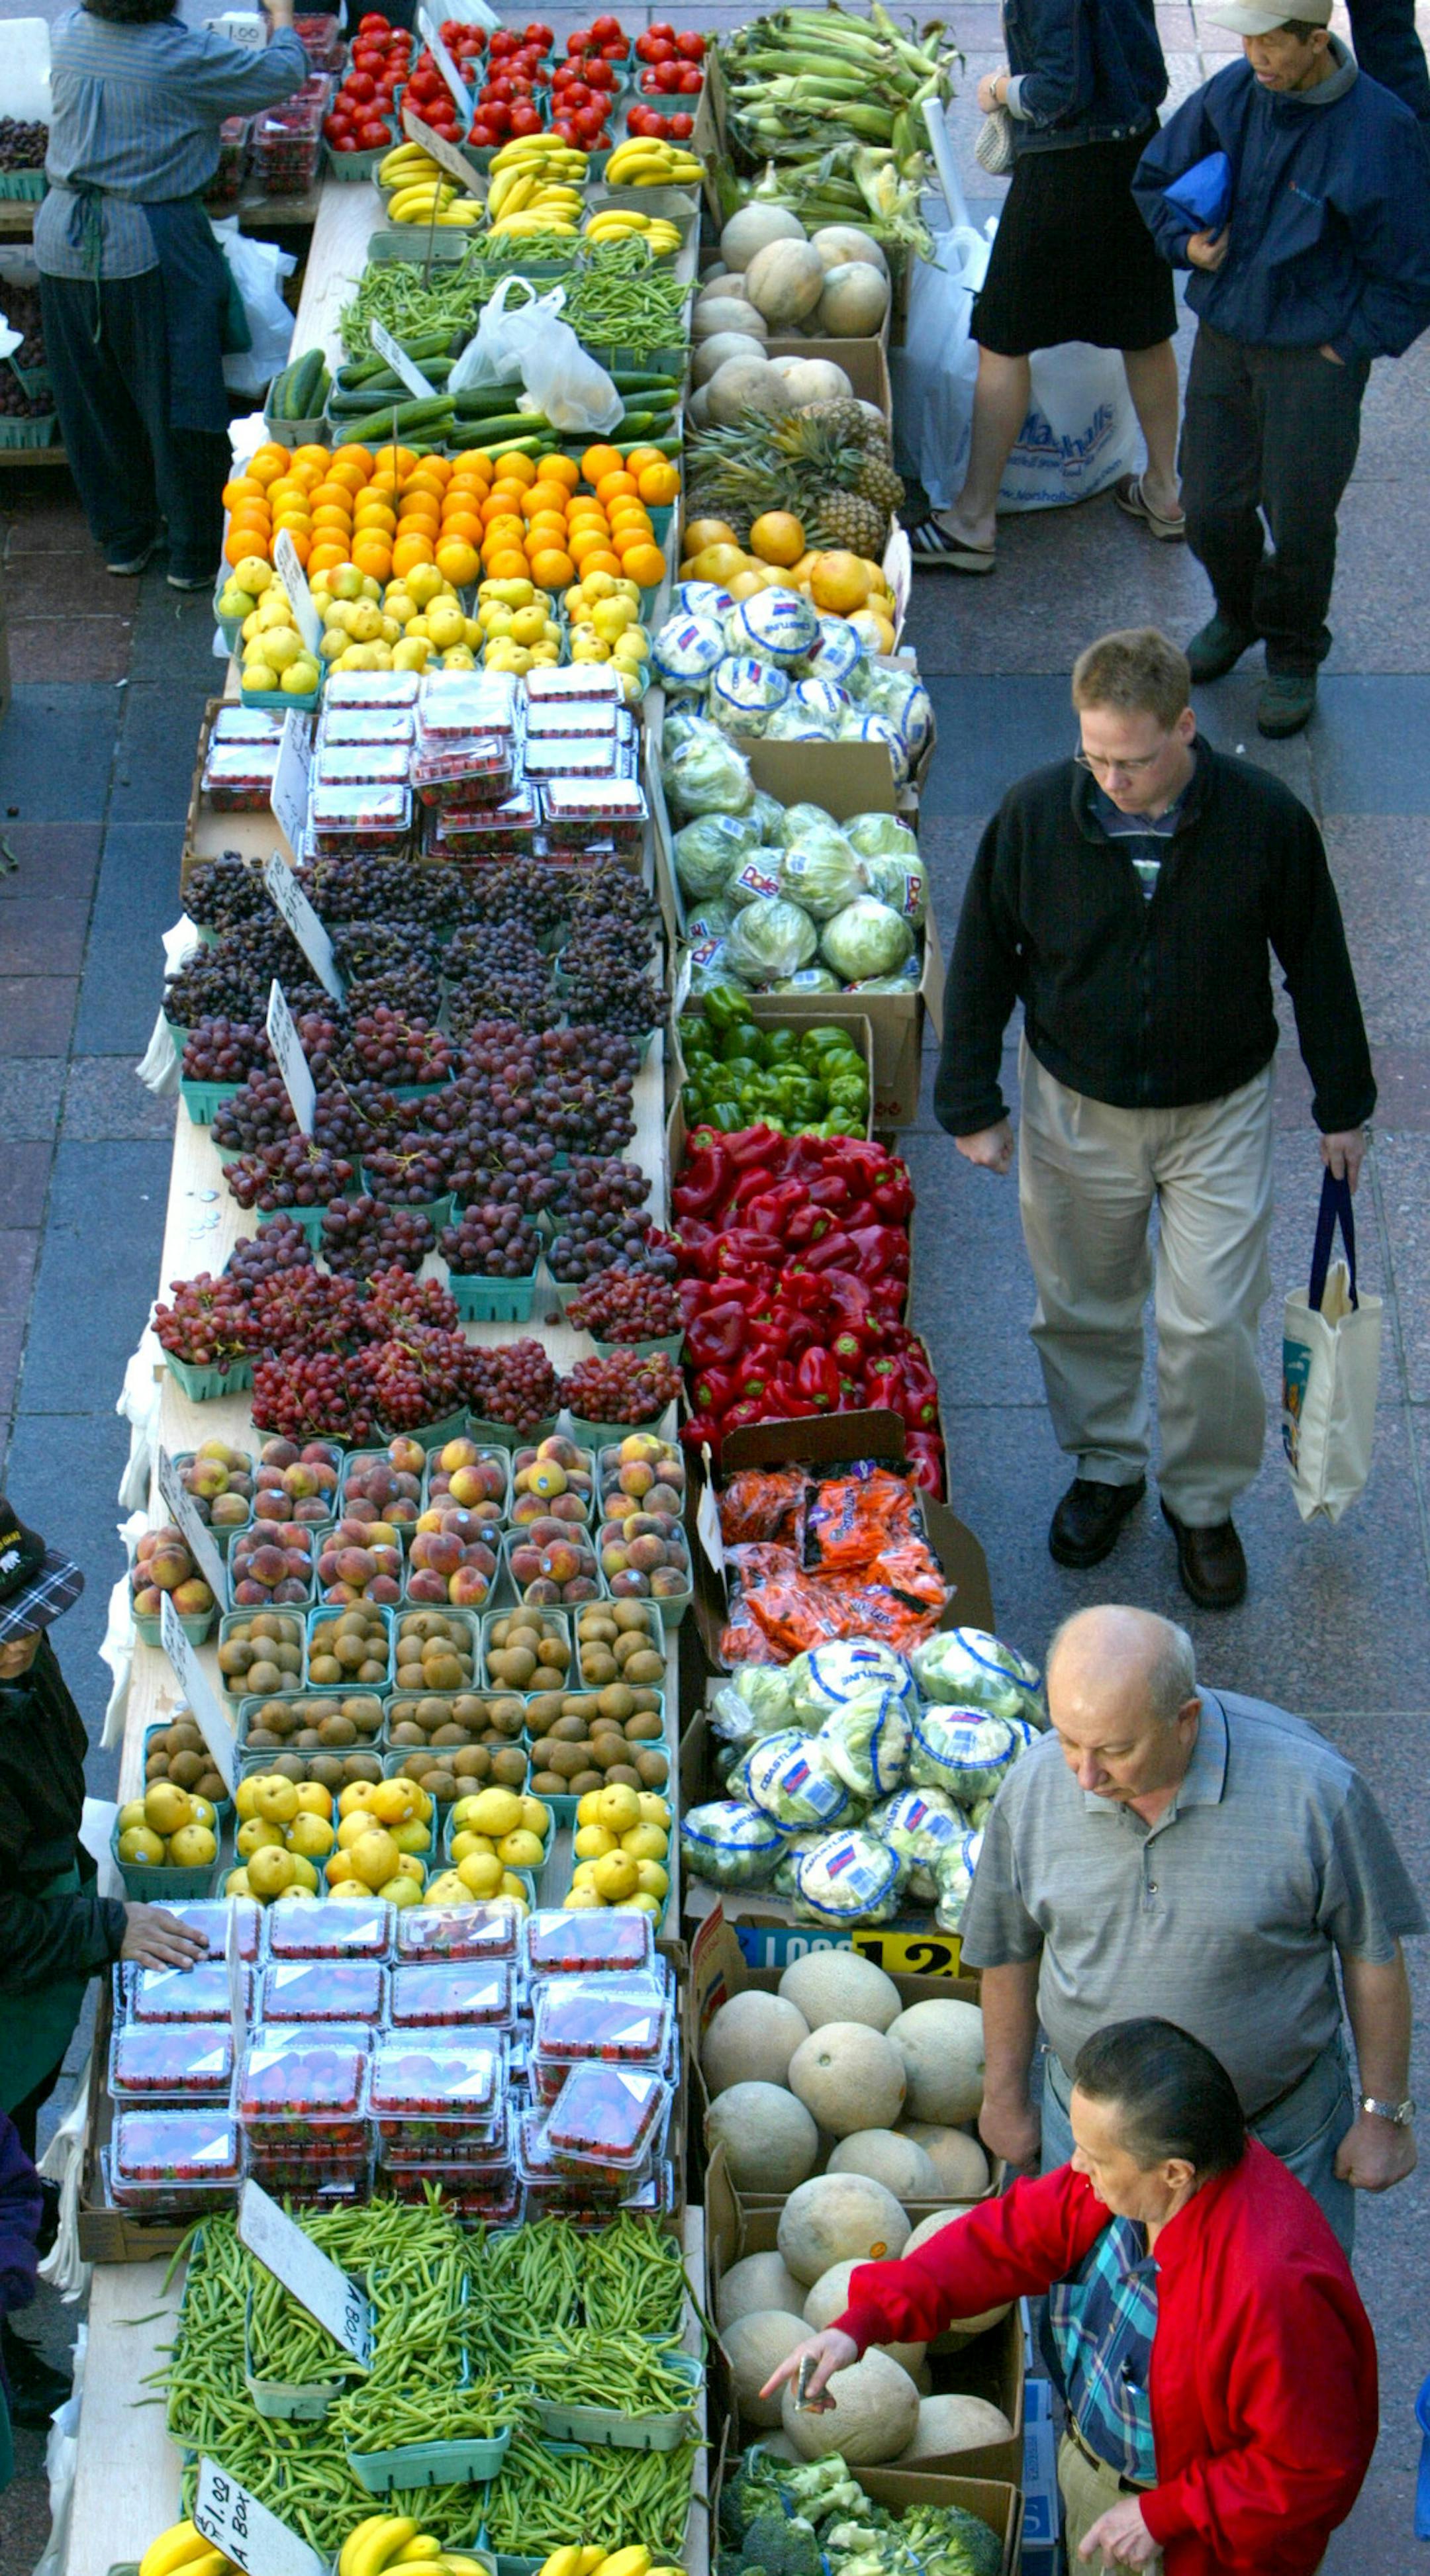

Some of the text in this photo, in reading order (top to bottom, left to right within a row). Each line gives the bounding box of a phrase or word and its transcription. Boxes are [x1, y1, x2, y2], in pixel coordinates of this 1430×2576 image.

[742, 865, 779, 896] Dole
[760, 1741, 804, 1791] COASTLINE
[804, 1829, 855, 1874] COASTLINE
[343, 2305, 360, 2346] BOX
[195, 2476, 230, 2542] $1.00
[230, 2491, 250, 2569] A BOX
